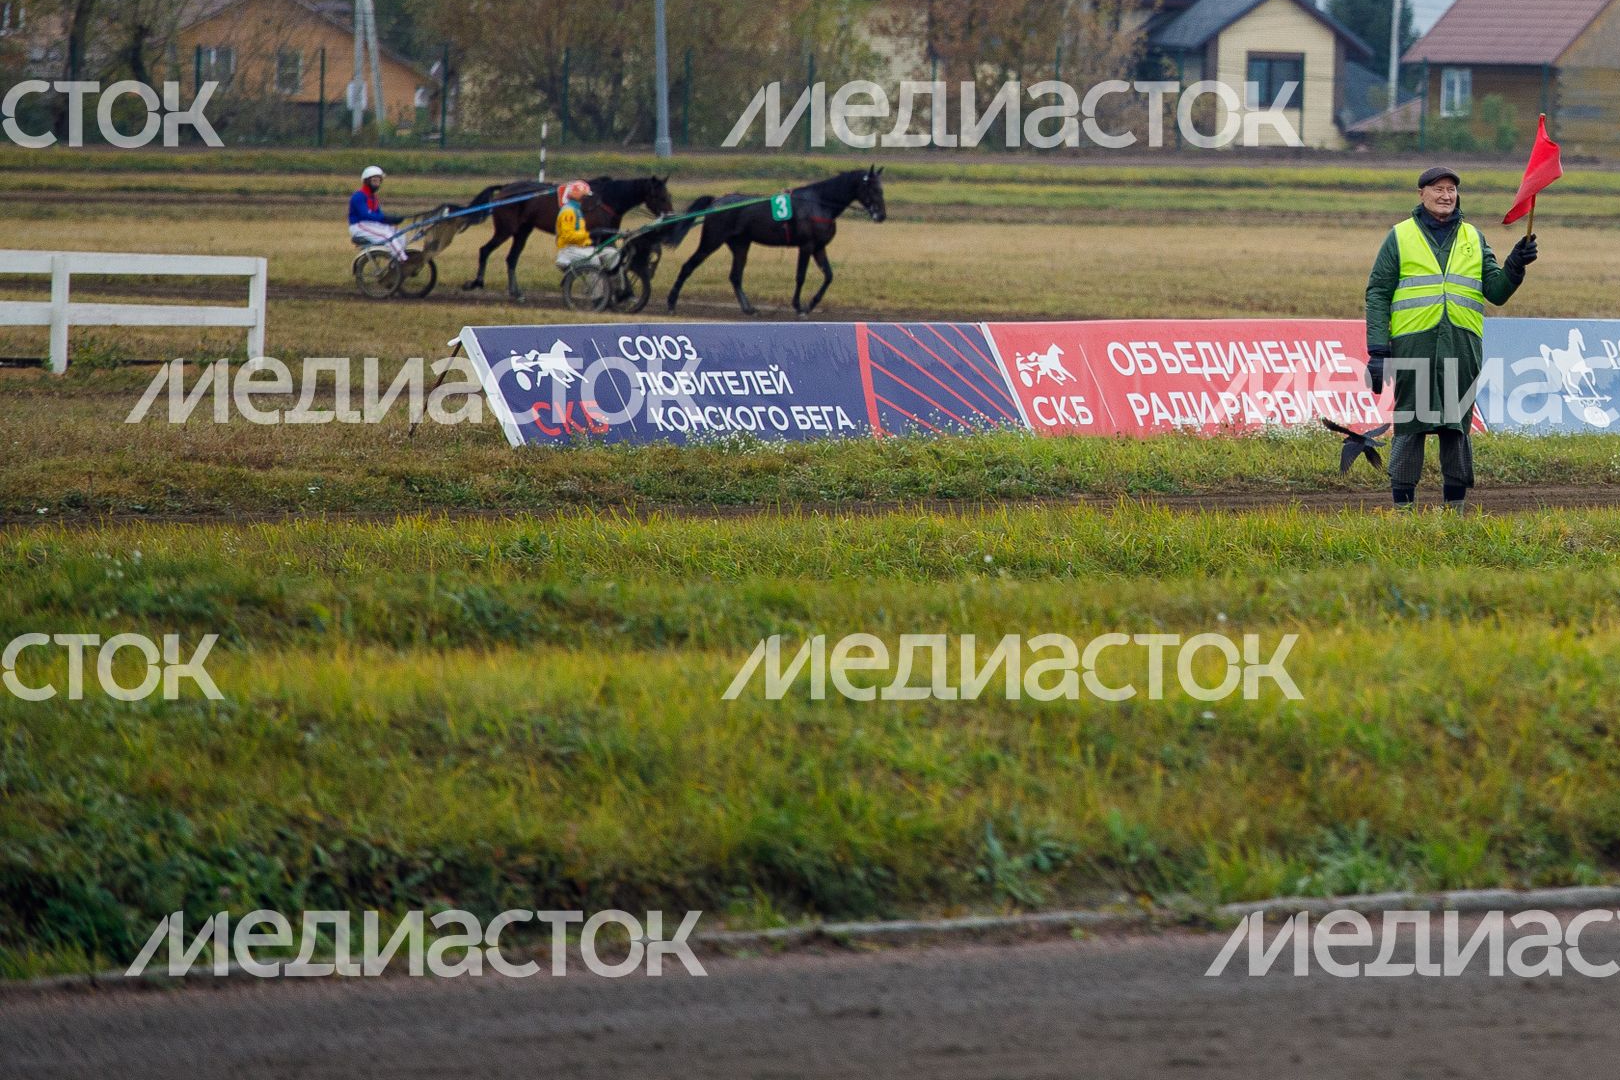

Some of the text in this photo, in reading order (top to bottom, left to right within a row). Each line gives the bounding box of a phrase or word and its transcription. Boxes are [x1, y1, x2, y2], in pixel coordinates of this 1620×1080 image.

[775, 194, 788, 219] 3
[618, 335, 697, 360] СОЮЗ
[1107, 340, 1352, 382] ОБЪЕДИНЕНИЕ
[636, 364, 794, 397] ЛЮБИТЕЛЕЙ
[531, 400, 609, 436] СКБ
[650, 405, 856, 432] КОНСКОГО БЕГА
[1032, 396, 1094, 426] СКБ
[1126, 391, 1384, 427] РАДИ РАЗВИТИЯ
